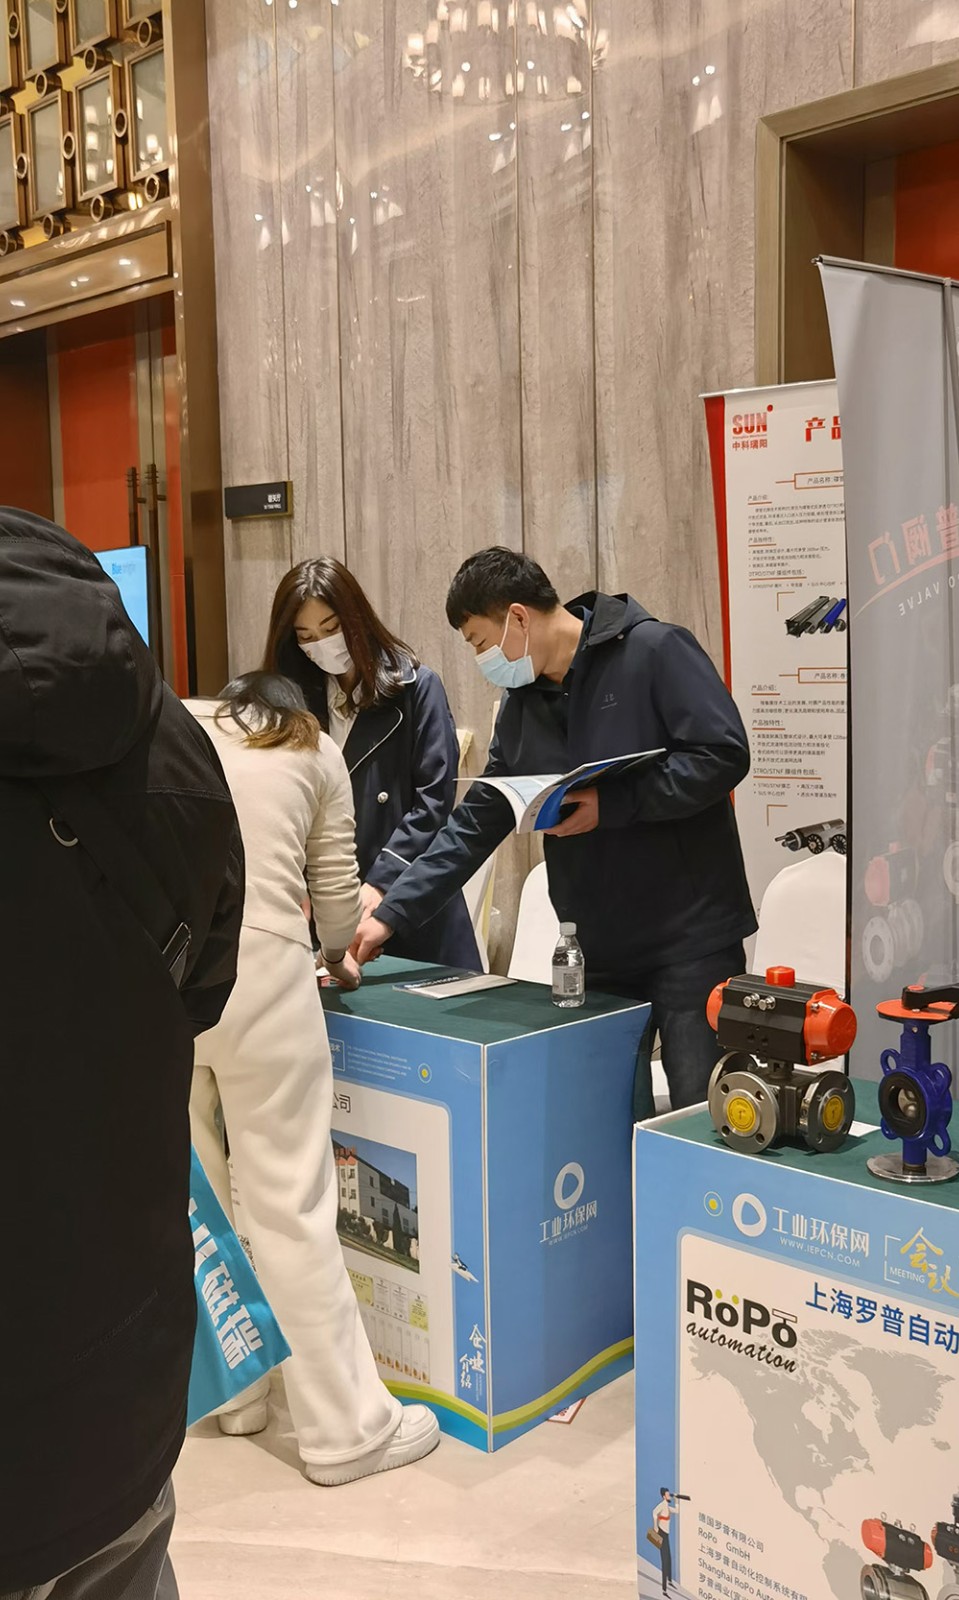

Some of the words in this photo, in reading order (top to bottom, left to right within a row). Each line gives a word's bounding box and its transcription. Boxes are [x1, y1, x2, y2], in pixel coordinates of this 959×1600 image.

[732, 412, 768, 435] SUN
[540, 1200, 597, 1243] 工业环保网
[772, 1206, 869, 1258] 工业环保网
[780, 1236, 861, 1268] WWW.IEPCN.COM
[900, 1226, 959, 1297] 会议
[890, 1266, 925, 1283] MEETING
[806, 1281, 959, 1354] 上海罗普自动
[686, 1321, 797, 1373] automation
[698, 1512, 764, 1553] 德国罗普有限公司
[698, 1527, 718, 1544] RoPo
[726, 1542, 750, 1561] GmbH
[698, 1558, 732, 1583] Shanghai
[734, 1577, 755, 1595] RoPo
